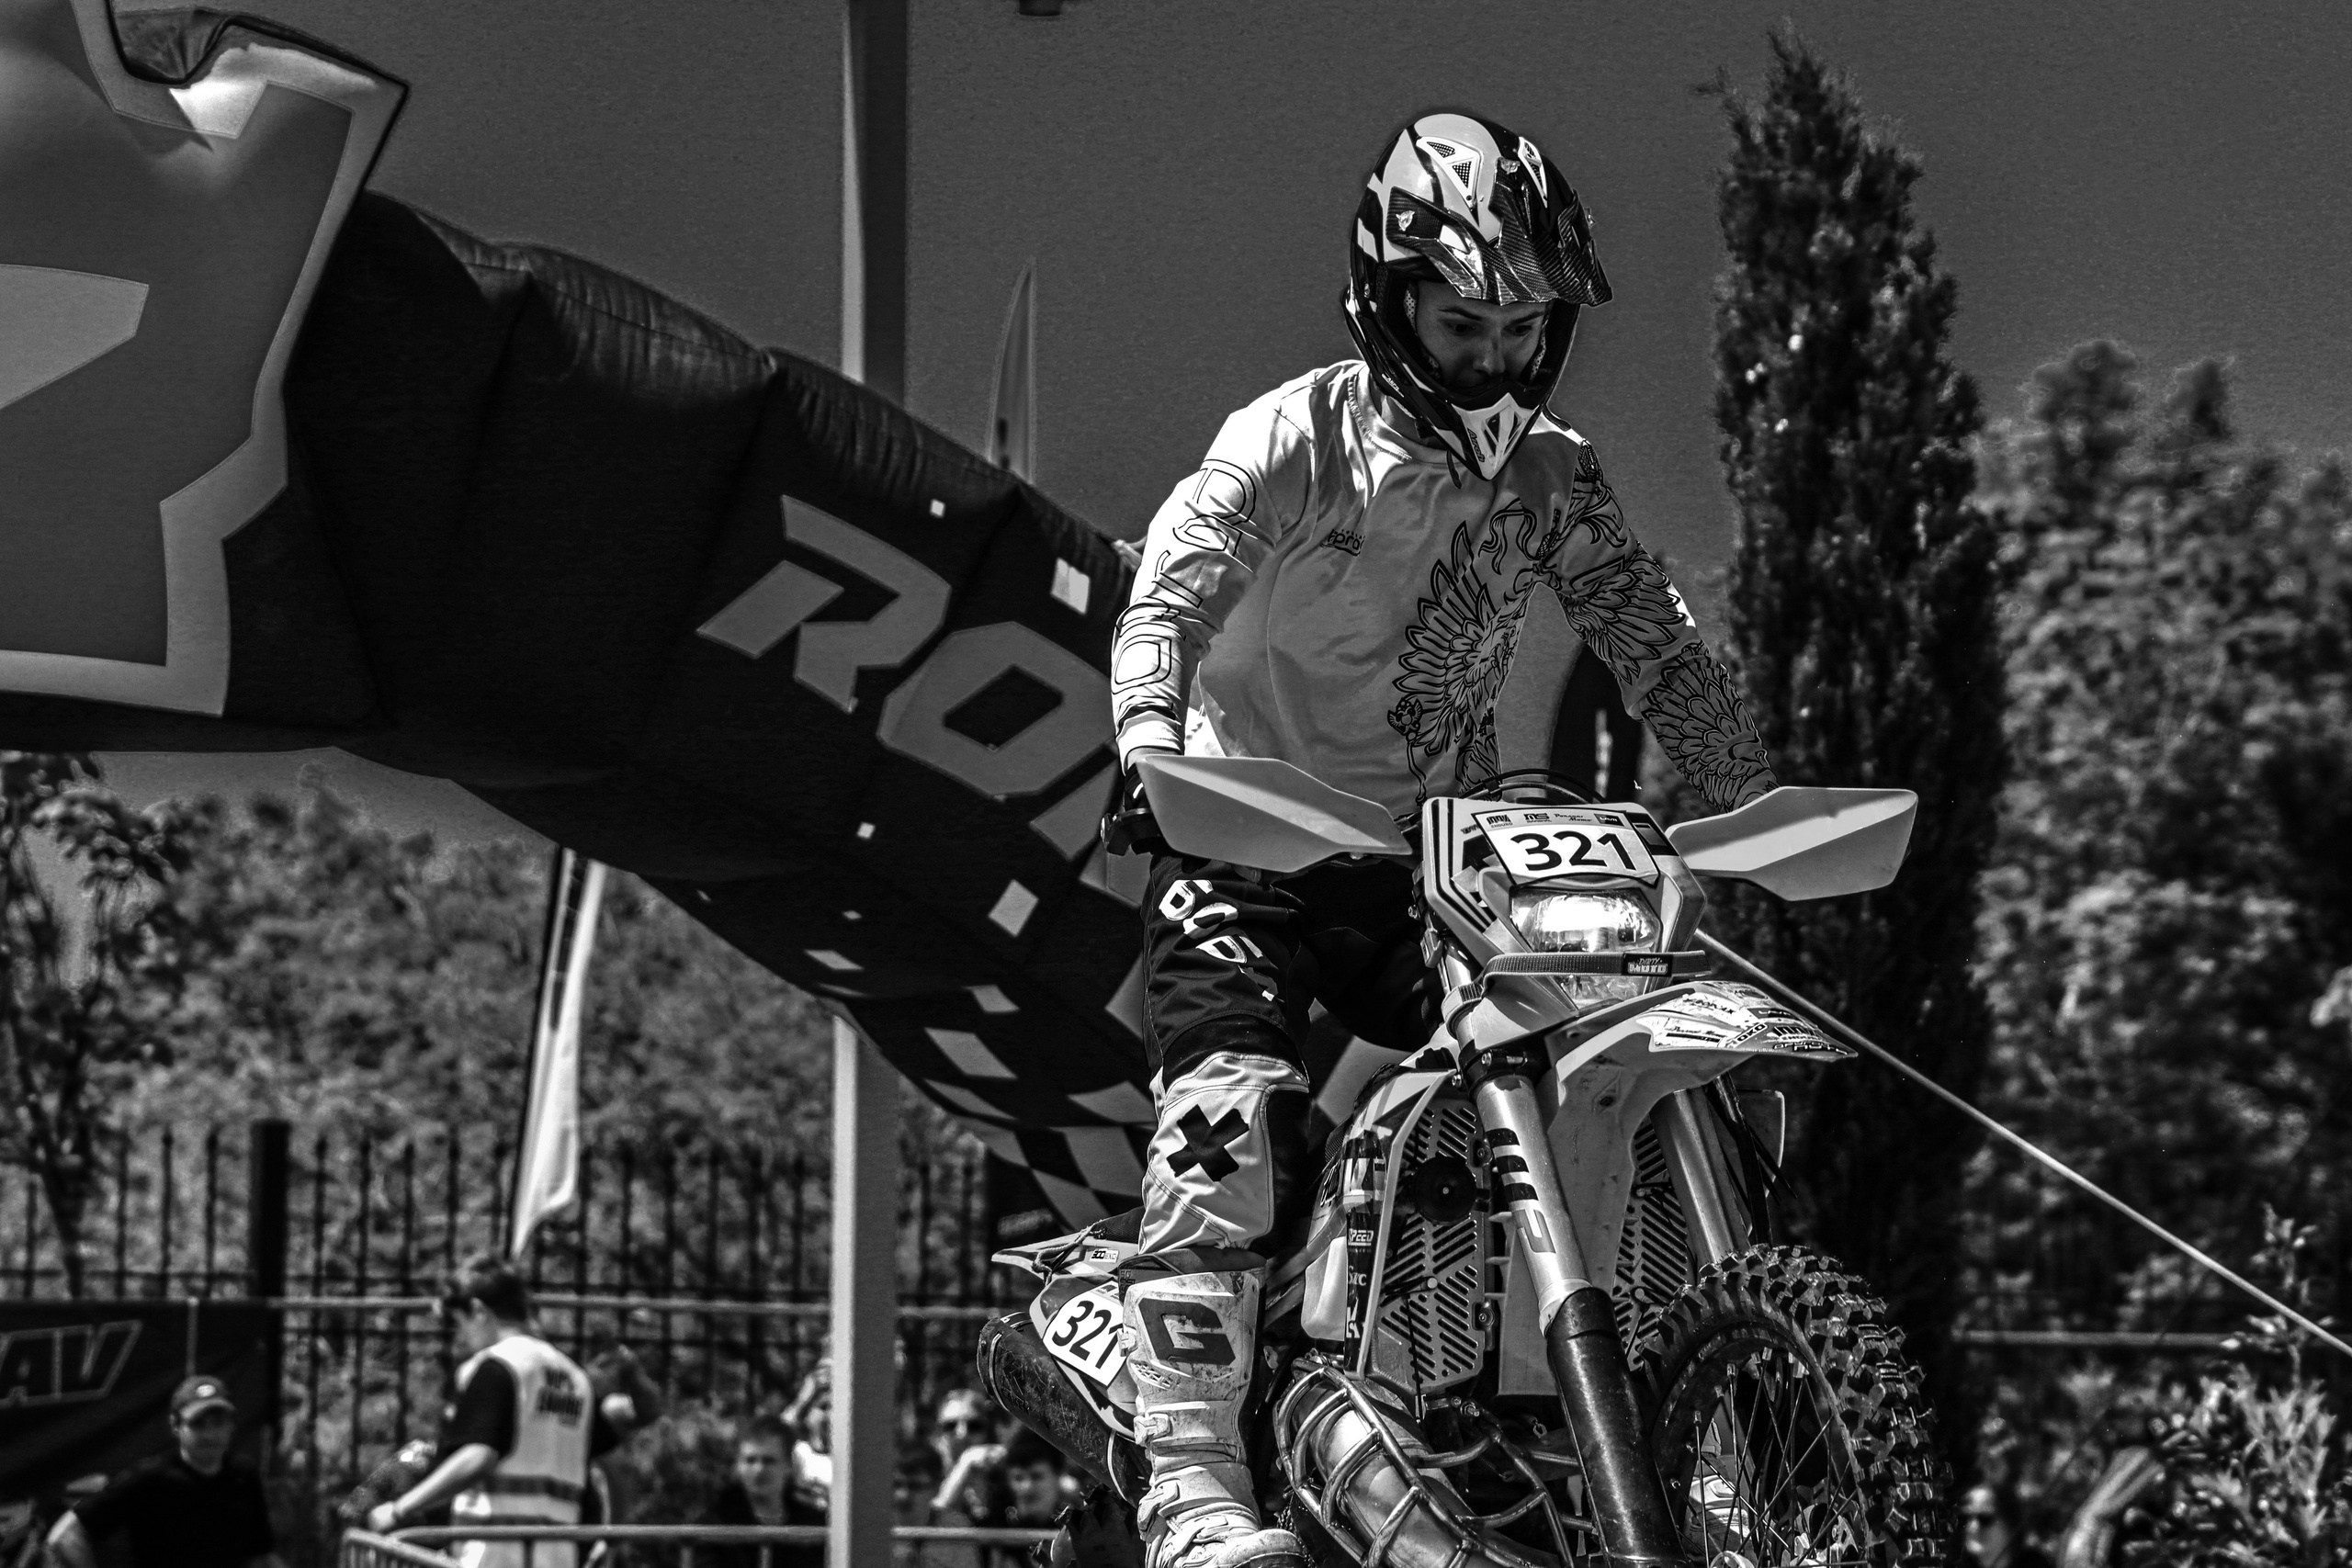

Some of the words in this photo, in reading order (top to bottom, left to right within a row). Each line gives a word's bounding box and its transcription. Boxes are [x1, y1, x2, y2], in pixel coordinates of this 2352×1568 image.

[1510, 830, 1636, 871] 321
[1627, 962, 1668, 975] MOTO
[1638, 957, 1660, 965] DIRTY
[1051, 1300, 1125, 1370] 321
